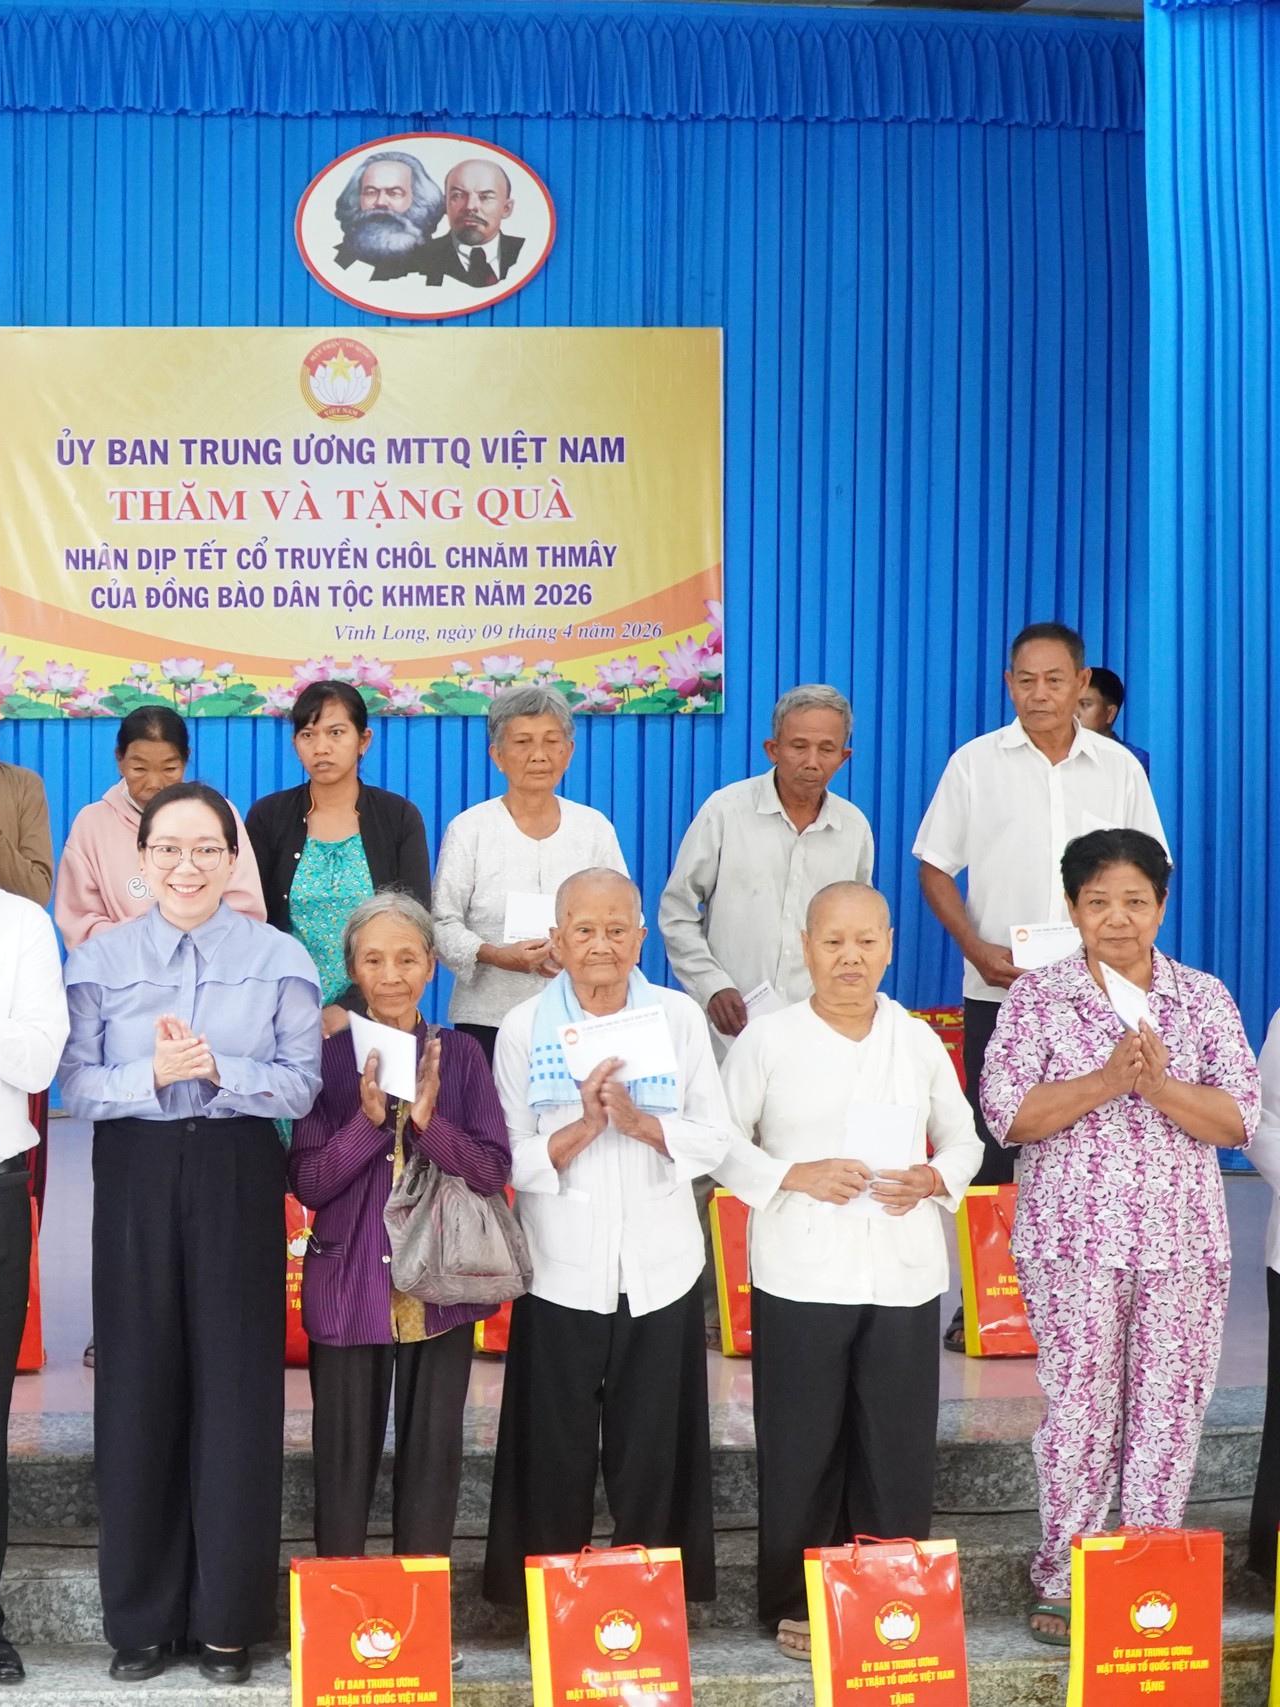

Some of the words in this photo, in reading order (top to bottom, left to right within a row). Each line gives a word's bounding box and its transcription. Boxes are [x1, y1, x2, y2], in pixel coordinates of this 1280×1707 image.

[57, 428, 96, 466] ỦY
[108, 439, 169, 466] BAN
[179, 438, 282, 466] TRUNG
[293, 433, 375, 465] ƯƠNG
[387, 437, 471, 469] MTTQ
[480, 429, 548, 470] VIỆT
[559, 436, 625, 464] NAM
[109, 481, 247, 521] THĂM
[261, 480, 323, 521] VÀ
[336, 480, 463, 528] TẶNG
[477, 478, 573, 526] QUÀ
[65, 543, 128, 570] NHÂN
[137, 548, 177, 576] DỊP
[183, 539, 228, 570] TẾT
[236, 536, 268, 570] CỔ
[274, 538, 368, 570] TRUYỀN
[376, 541, 437, 569] CHÔL
[445, 542, 528, 569] CHNĂM
[535, 539, 617, 568] THMÂY
[91, 578, 137, 609] CỦA
[145, 577, 209, 609] ĐỒNG
[218, 580, 265, 608] BÀO
[273, 579, 320, 608] DÂN
[327, 579, 373, 613] TỘC
[382, 584, 466, 607] KHMER
[475, 580, 525, 606] NĂM
[534, 583, 593, 606] 2026
[334, 624, 376, 640] Vĩnh
[381, 624, 430, 642] Long,
[436, 624, 477, 643] ngày
[482, 624, 503, 639] 09
[508, 623, 557, 642] tháng
[562, 623, 573, 638] 4
[578, 623, 615, 638] năm
[621, 622, 663, 638] 2026
[1113, 1647, 1124, 1659] ỦY
[1125, 1648, 1143, 1658] BAN
[1144, 1647, 1170, 1657] TRUNG
[1171, 1646, 1194, 1656] ƯƠNG
[862, 1660, 872, 1673] ỦY
[873, 1661, 890, 1672] BAN
[891, 1658, 917, 1670] TRUNG
[917, 1656, 939, 1667] ƯƠNG
[334, 1677, 346, 1690] ỦY
[347, 1679, 365, 1690] BAN
[367, 1678, 394, 1688] TRUNG
[396, 1677, 419, 1687] ƯƠNG
[1139, 1679, 1165, 1694] TẶNG
[890, 1692, 915, 1707] TẶNG
